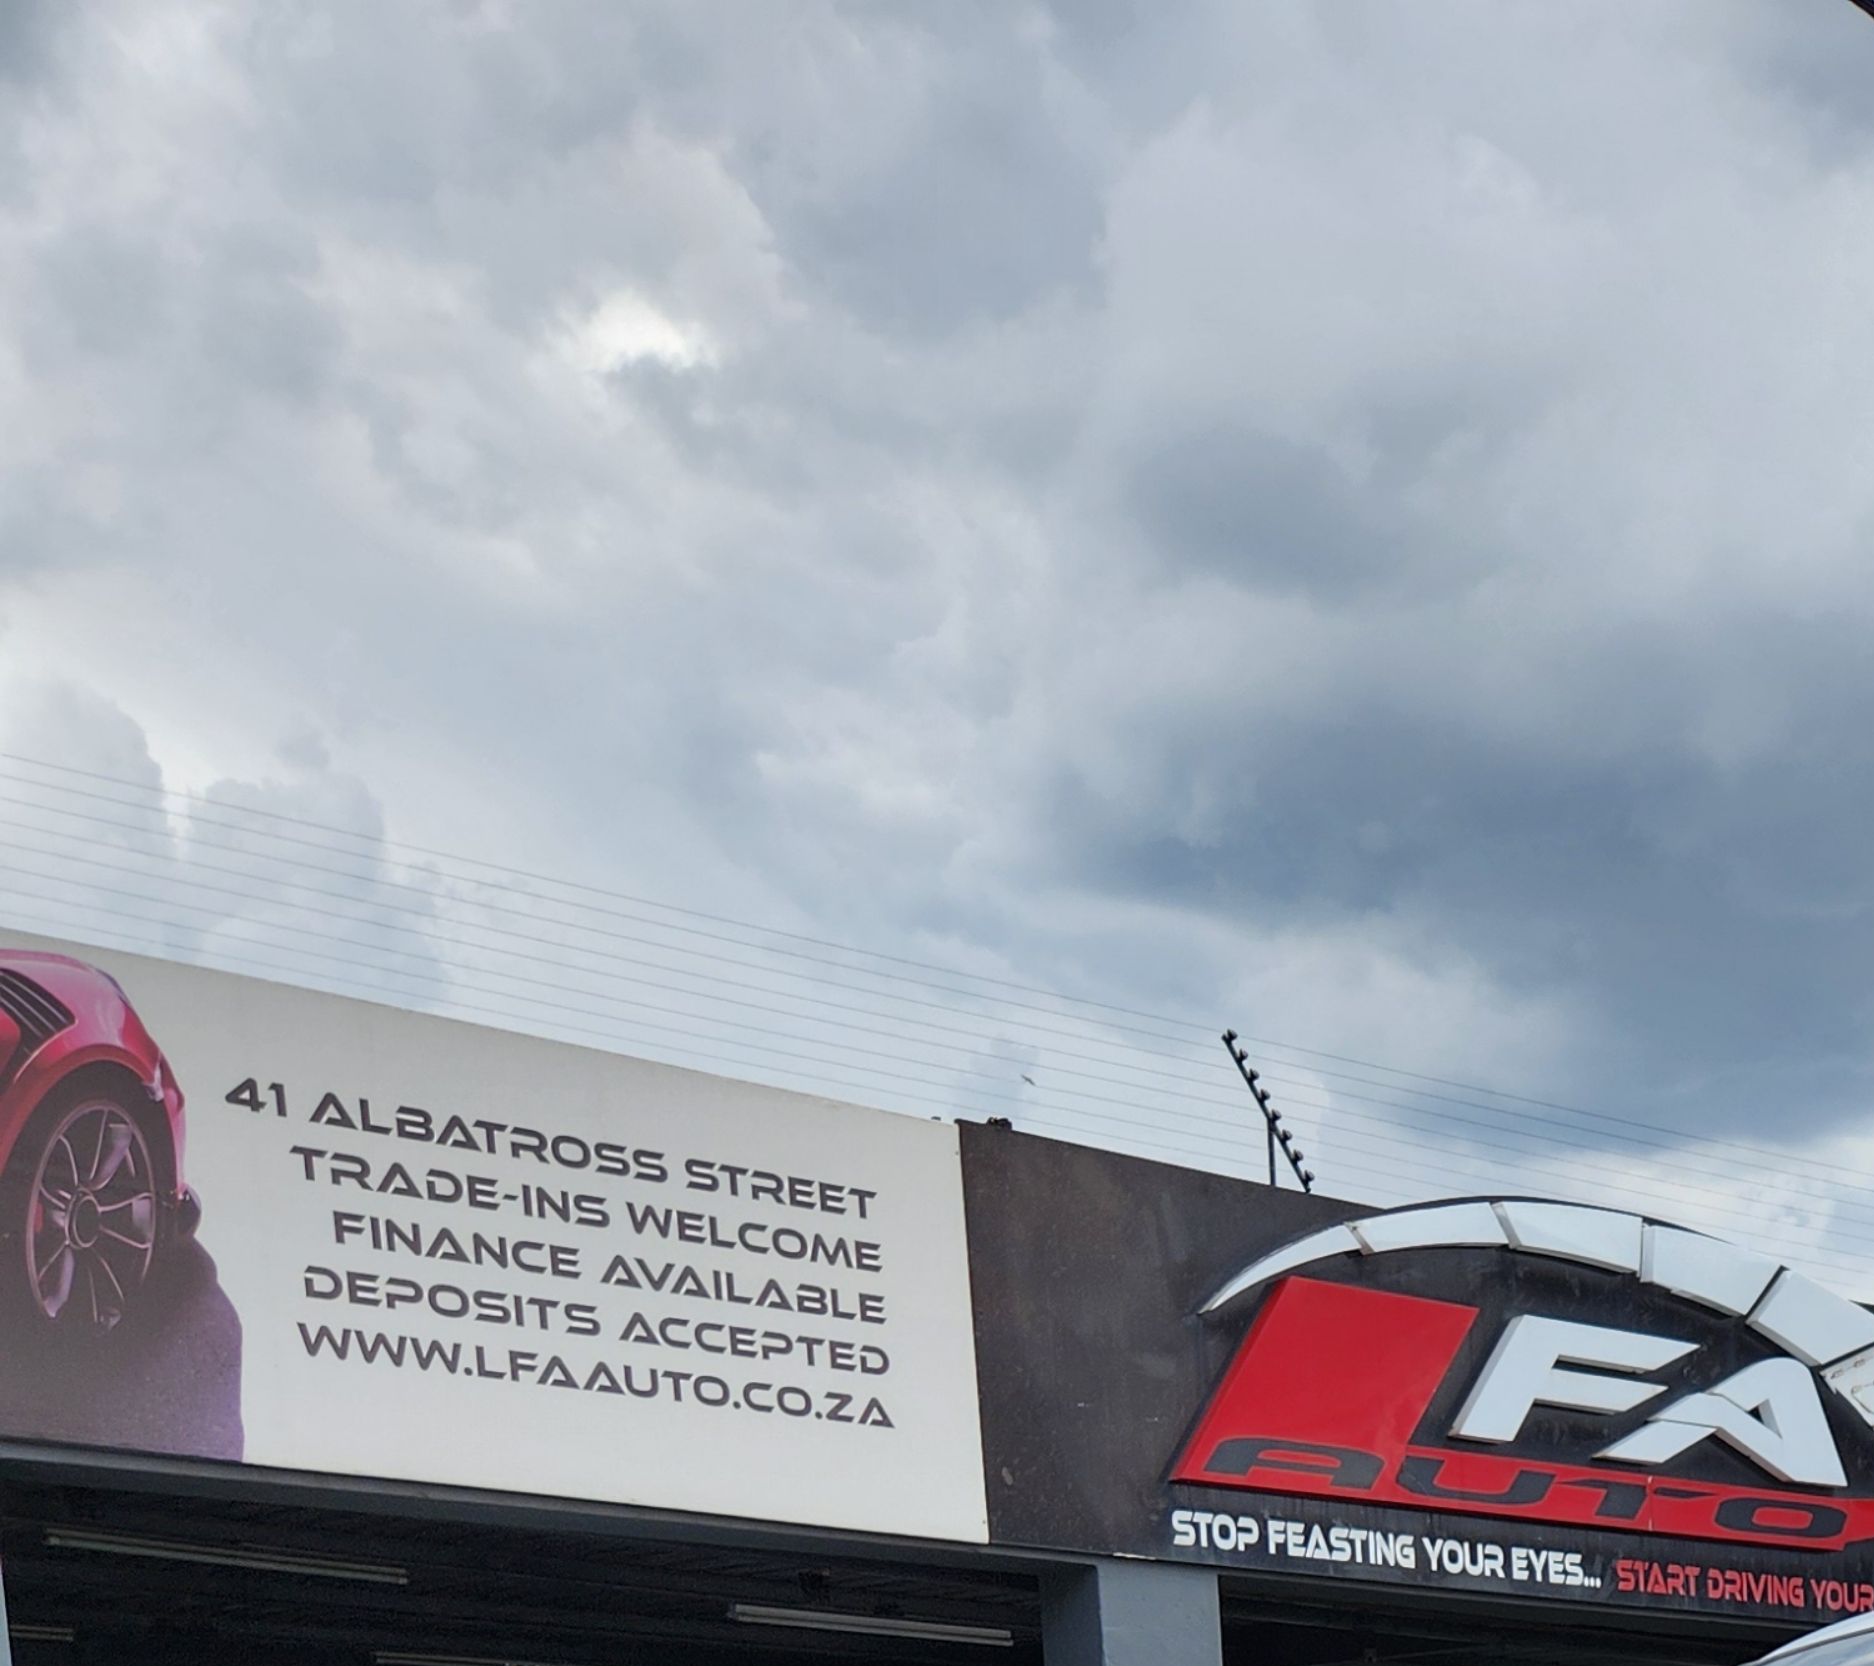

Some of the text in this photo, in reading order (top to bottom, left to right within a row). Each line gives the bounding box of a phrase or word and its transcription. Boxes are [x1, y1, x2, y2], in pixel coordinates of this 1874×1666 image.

[224, 1077, 878, 1220] 41 ALBATROSS STREET
[289, 1145, 886, 1273] TRADE-INS WELCOME
[303, 1264, 891, 1376] DEPOSITS ACCEPTED
[332, 1210, 888, 1325] FINANCE AVAILABLE
[296, 1321, 897, 1430] WWW.LFAAUTO.CO.ZA
[1200, 1436, 1848, 1540] AUTO
[1171, 1509, 1261, 1552] STOP
[1267, 1519, 1417, 1570] FEASTING
[1420, 1536, 1506, 1579] YOUR
[1511, 1546, 1603, 1590] EYES...
[1615, 1558, 1703, 1599] START
[1706, 1567, 1806, 1609] DRIVING
